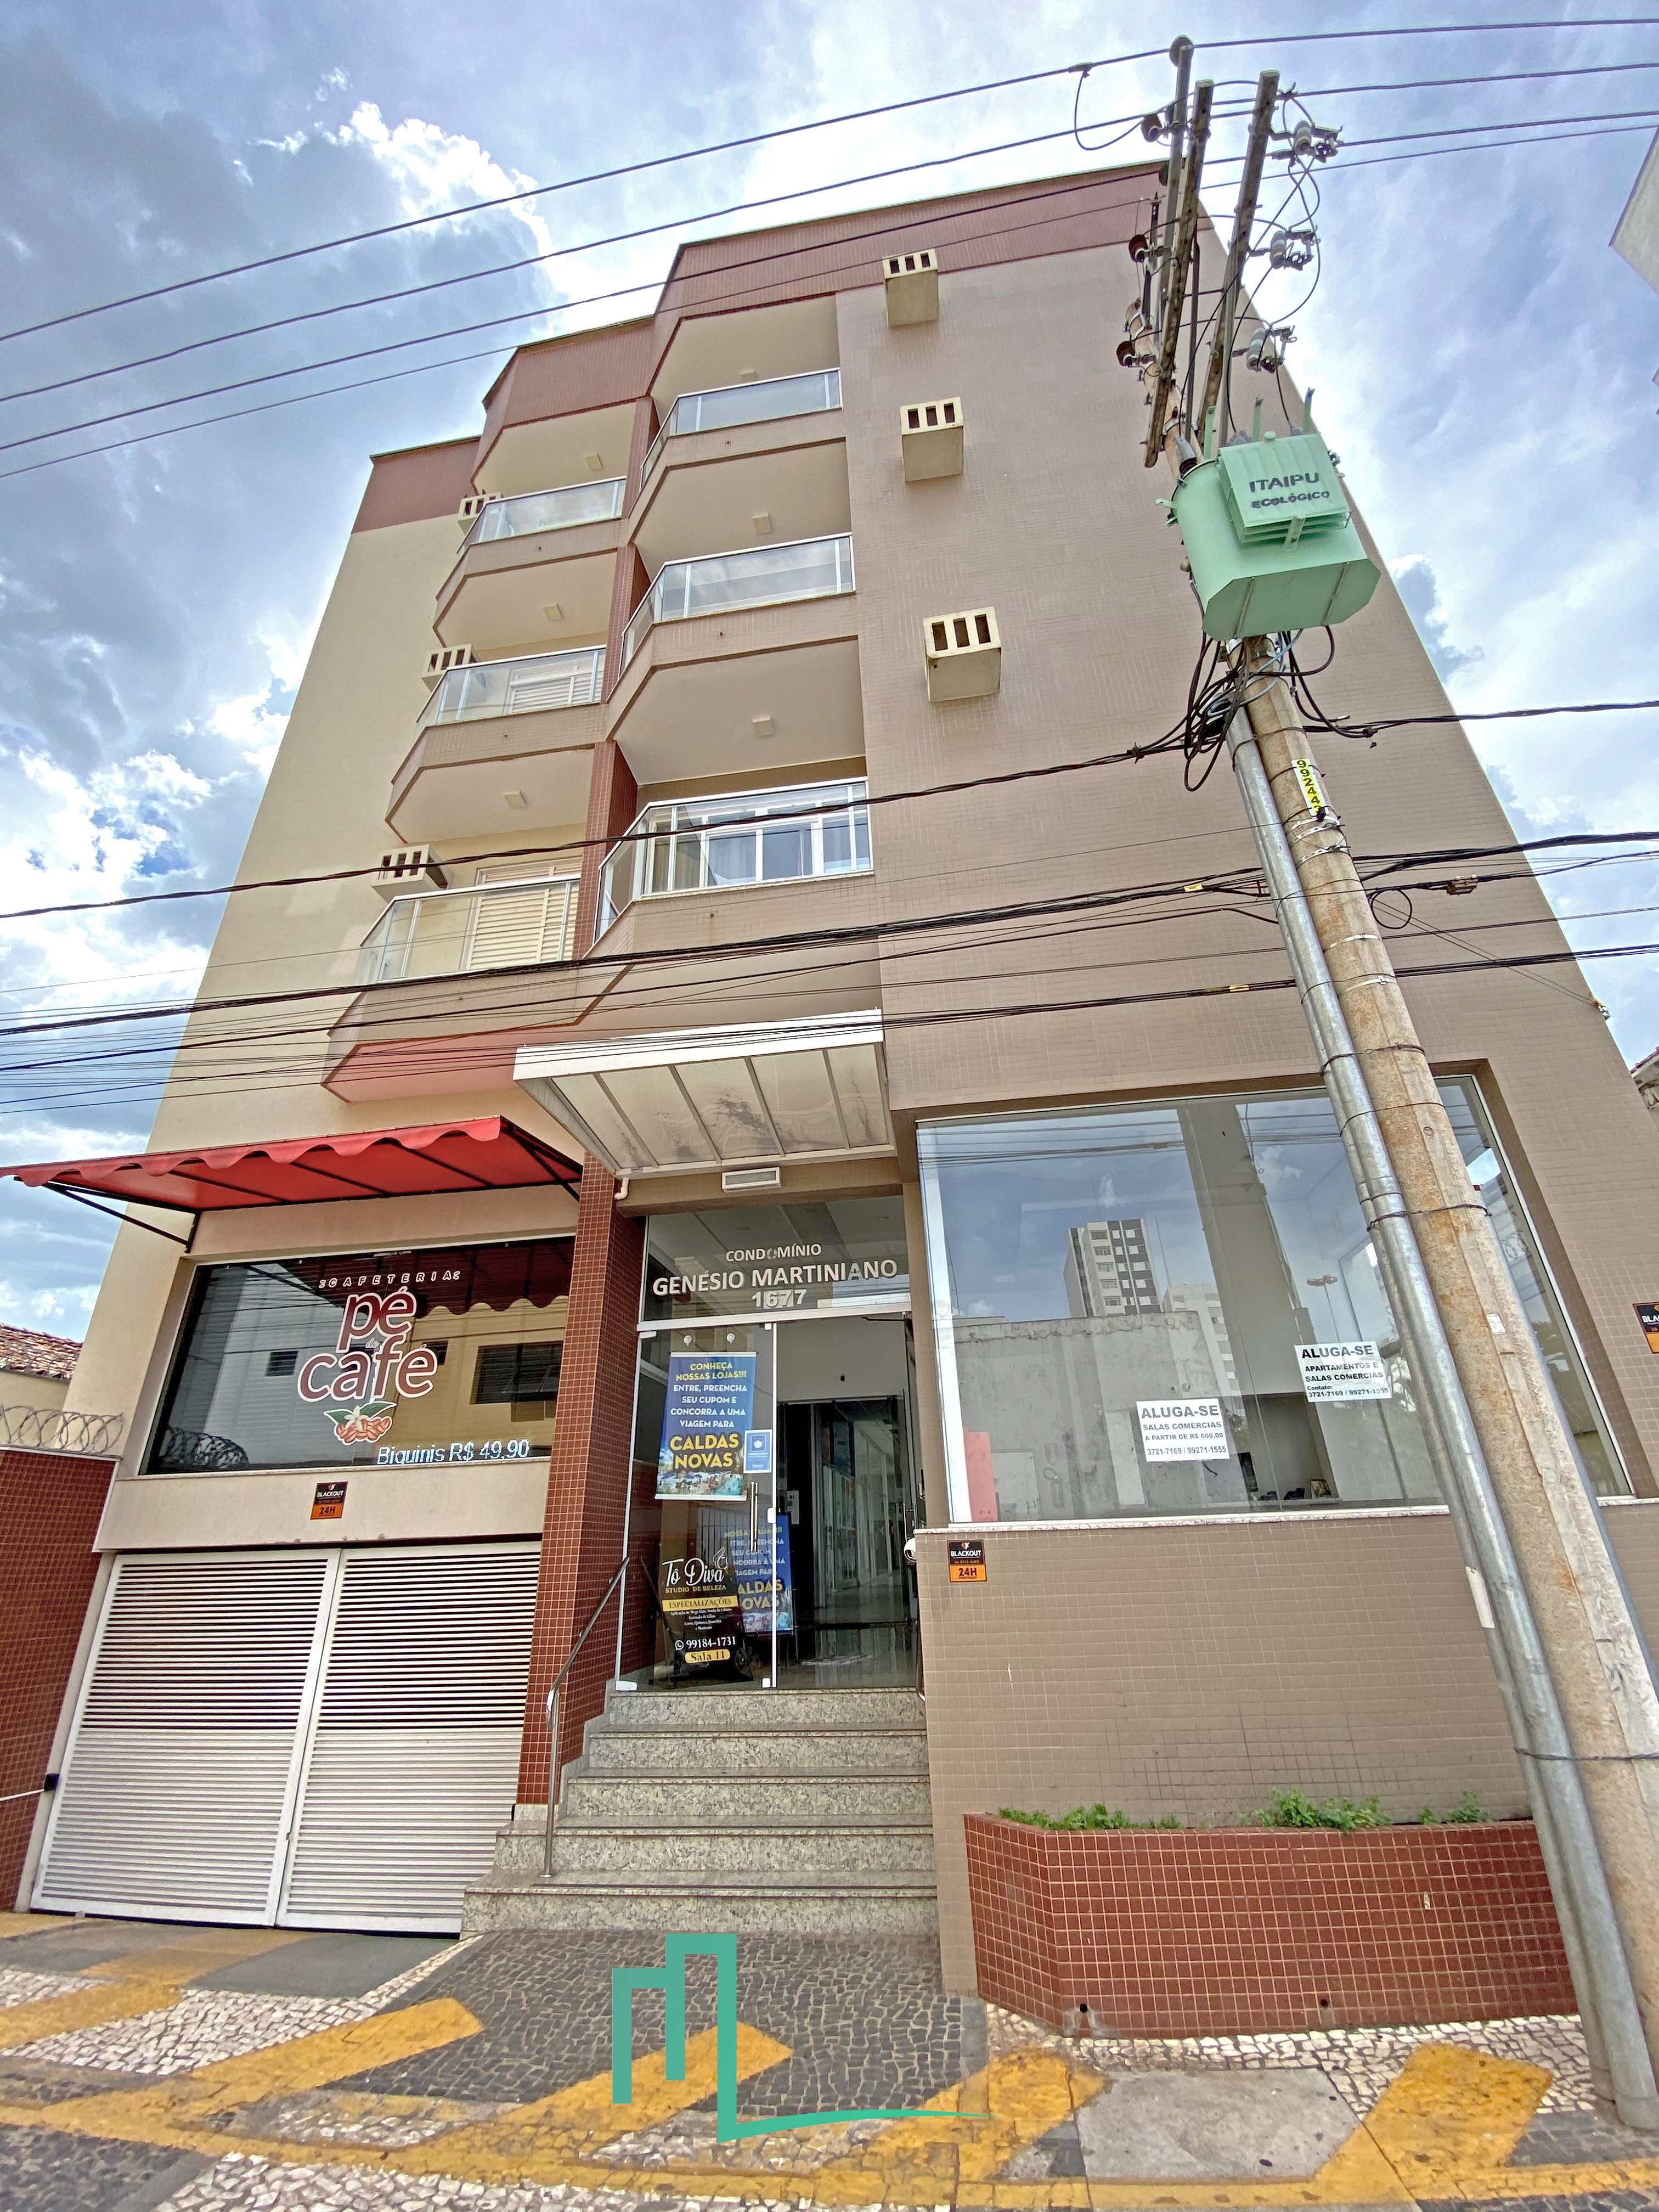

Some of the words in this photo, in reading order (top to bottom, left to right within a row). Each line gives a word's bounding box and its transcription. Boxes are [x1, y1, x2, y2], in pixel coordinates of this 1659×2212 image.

[1249, 472, 1319, 493] ITAIPU
[1251, 491, 1330, 508] ECOLÓGICO
[725, 1242, 822, 1262] CONDOMÍNIO
[328, 1270, 452, 1288] CAFETERIA
[652, 1269, 744, 1296] GENÉSIO
[752, 1259, 898, 1287] MARTINIANO
[752, 1289, 807, 1309] 1677
[336, 1286, 417, 1353] pé
[365, 1337, 380, 1349] de
[1302, 1345, 1374, 1358] ALUGA-SE
[297, 1333, 438, 1402] café
[690, 1361, 732, 1371] CONHEÇA
[1305, 1363, 1370, 1372] APARTAMENTOS
[675, 1372, 710, 1381] NOSSAS
[712, 1370, 747, 1379] LOJAS!!!
[1334, 1372, 1383, 1380] COMERCIAS
[1142, 1405, 1219, 1419] ALUGA-SE
[669, 1433, 739, 1451] CALDAS
[377, 1444, 445, 1465] Biquinis
[449, 1440, 475, 1461] R$
[479, 1439, 530, 1460] 49.90
[674, 1452, 733, 1469] NOVAS
[320, 1506, 335, 1514] 24H
[662, 1558, 684, 1587] Tô
[684, 1557, 724, 1586] Diva
[958, 1568, 977, 1576] 24H
[738, 1579, 783, 1594] ALDAS
[669, 1597, 732, 1608] ESPECIALIZAÇÕES
[686, 1636, 736, 1649] 99184-1731
[691, 1652, 712, 1662] Sala
[716, 1651, 725, 1659] 11
